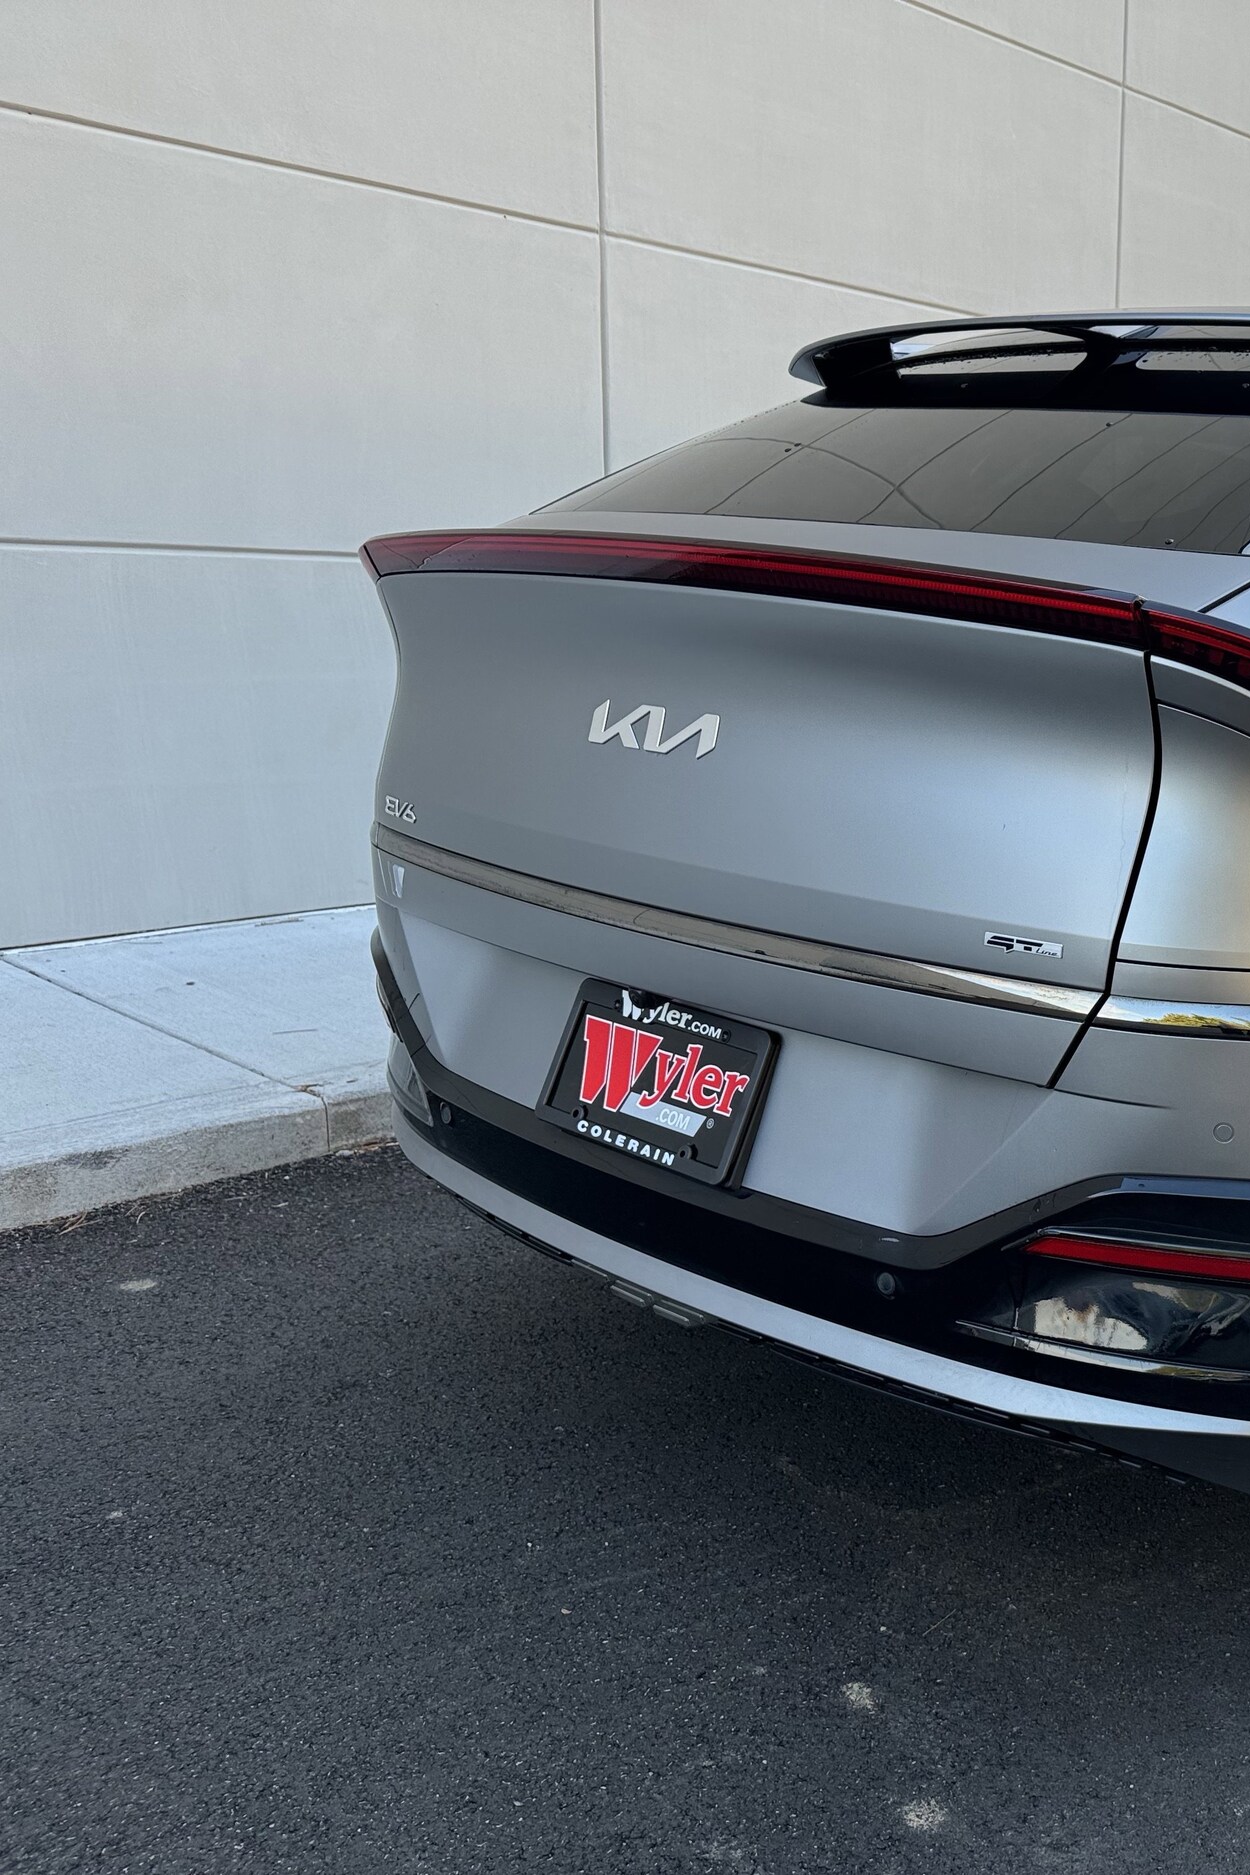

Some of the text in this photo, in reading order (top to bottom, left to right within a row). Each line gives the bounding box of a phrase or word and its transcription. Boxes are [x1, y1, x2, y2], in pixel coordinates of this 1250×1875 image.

[588, 699, 720, 760] KIA
[384, 794, 417, 824] EV6
[579, 1014, 750, 1118] Wyler
[576, 1119, 676, 1167] COLERAIN
[655, 1108, 691, 1131] .COM
